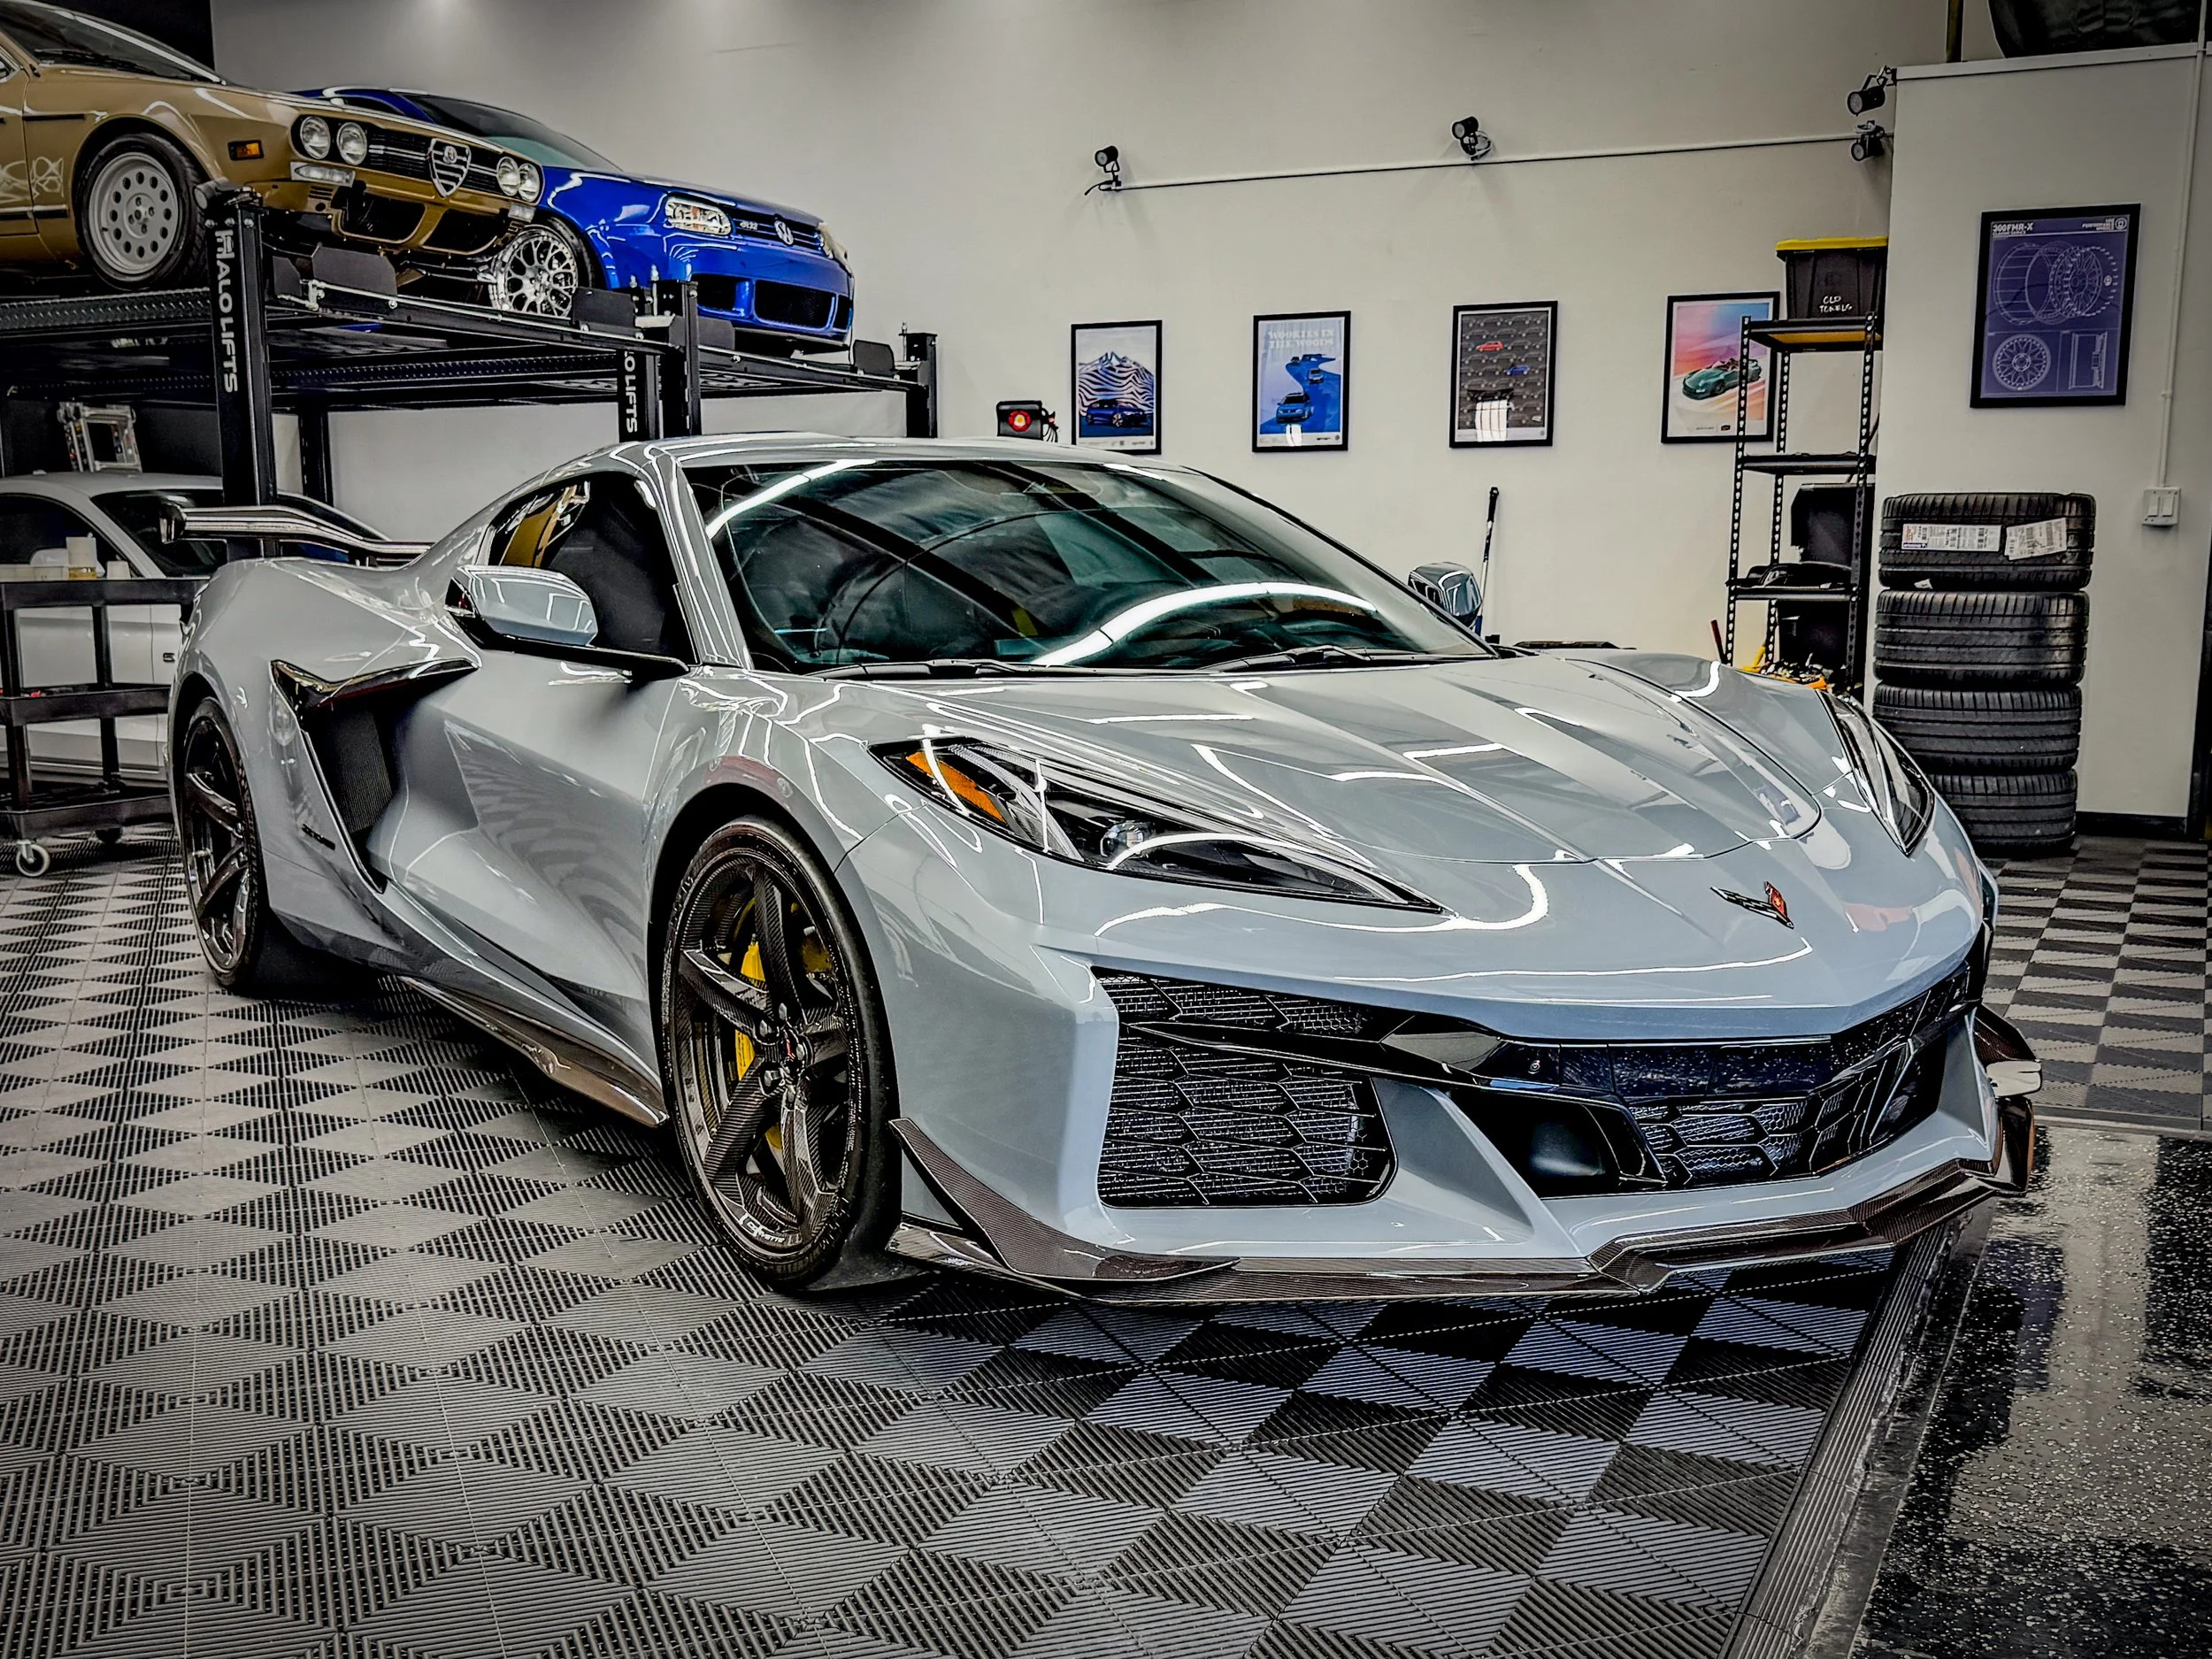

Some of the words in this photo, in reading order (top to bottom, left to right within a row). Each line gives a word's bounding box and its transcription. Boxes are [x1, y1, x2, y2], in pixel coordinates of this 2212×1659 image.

[214, 229, 235, 314] HALO
[219, 317, 238, 393] LIFTS
[1268, 340, 1291, 349] THE
[1295, 338, 1334, 348] WOODS
[625, 375, 638, 433] LIFTS
